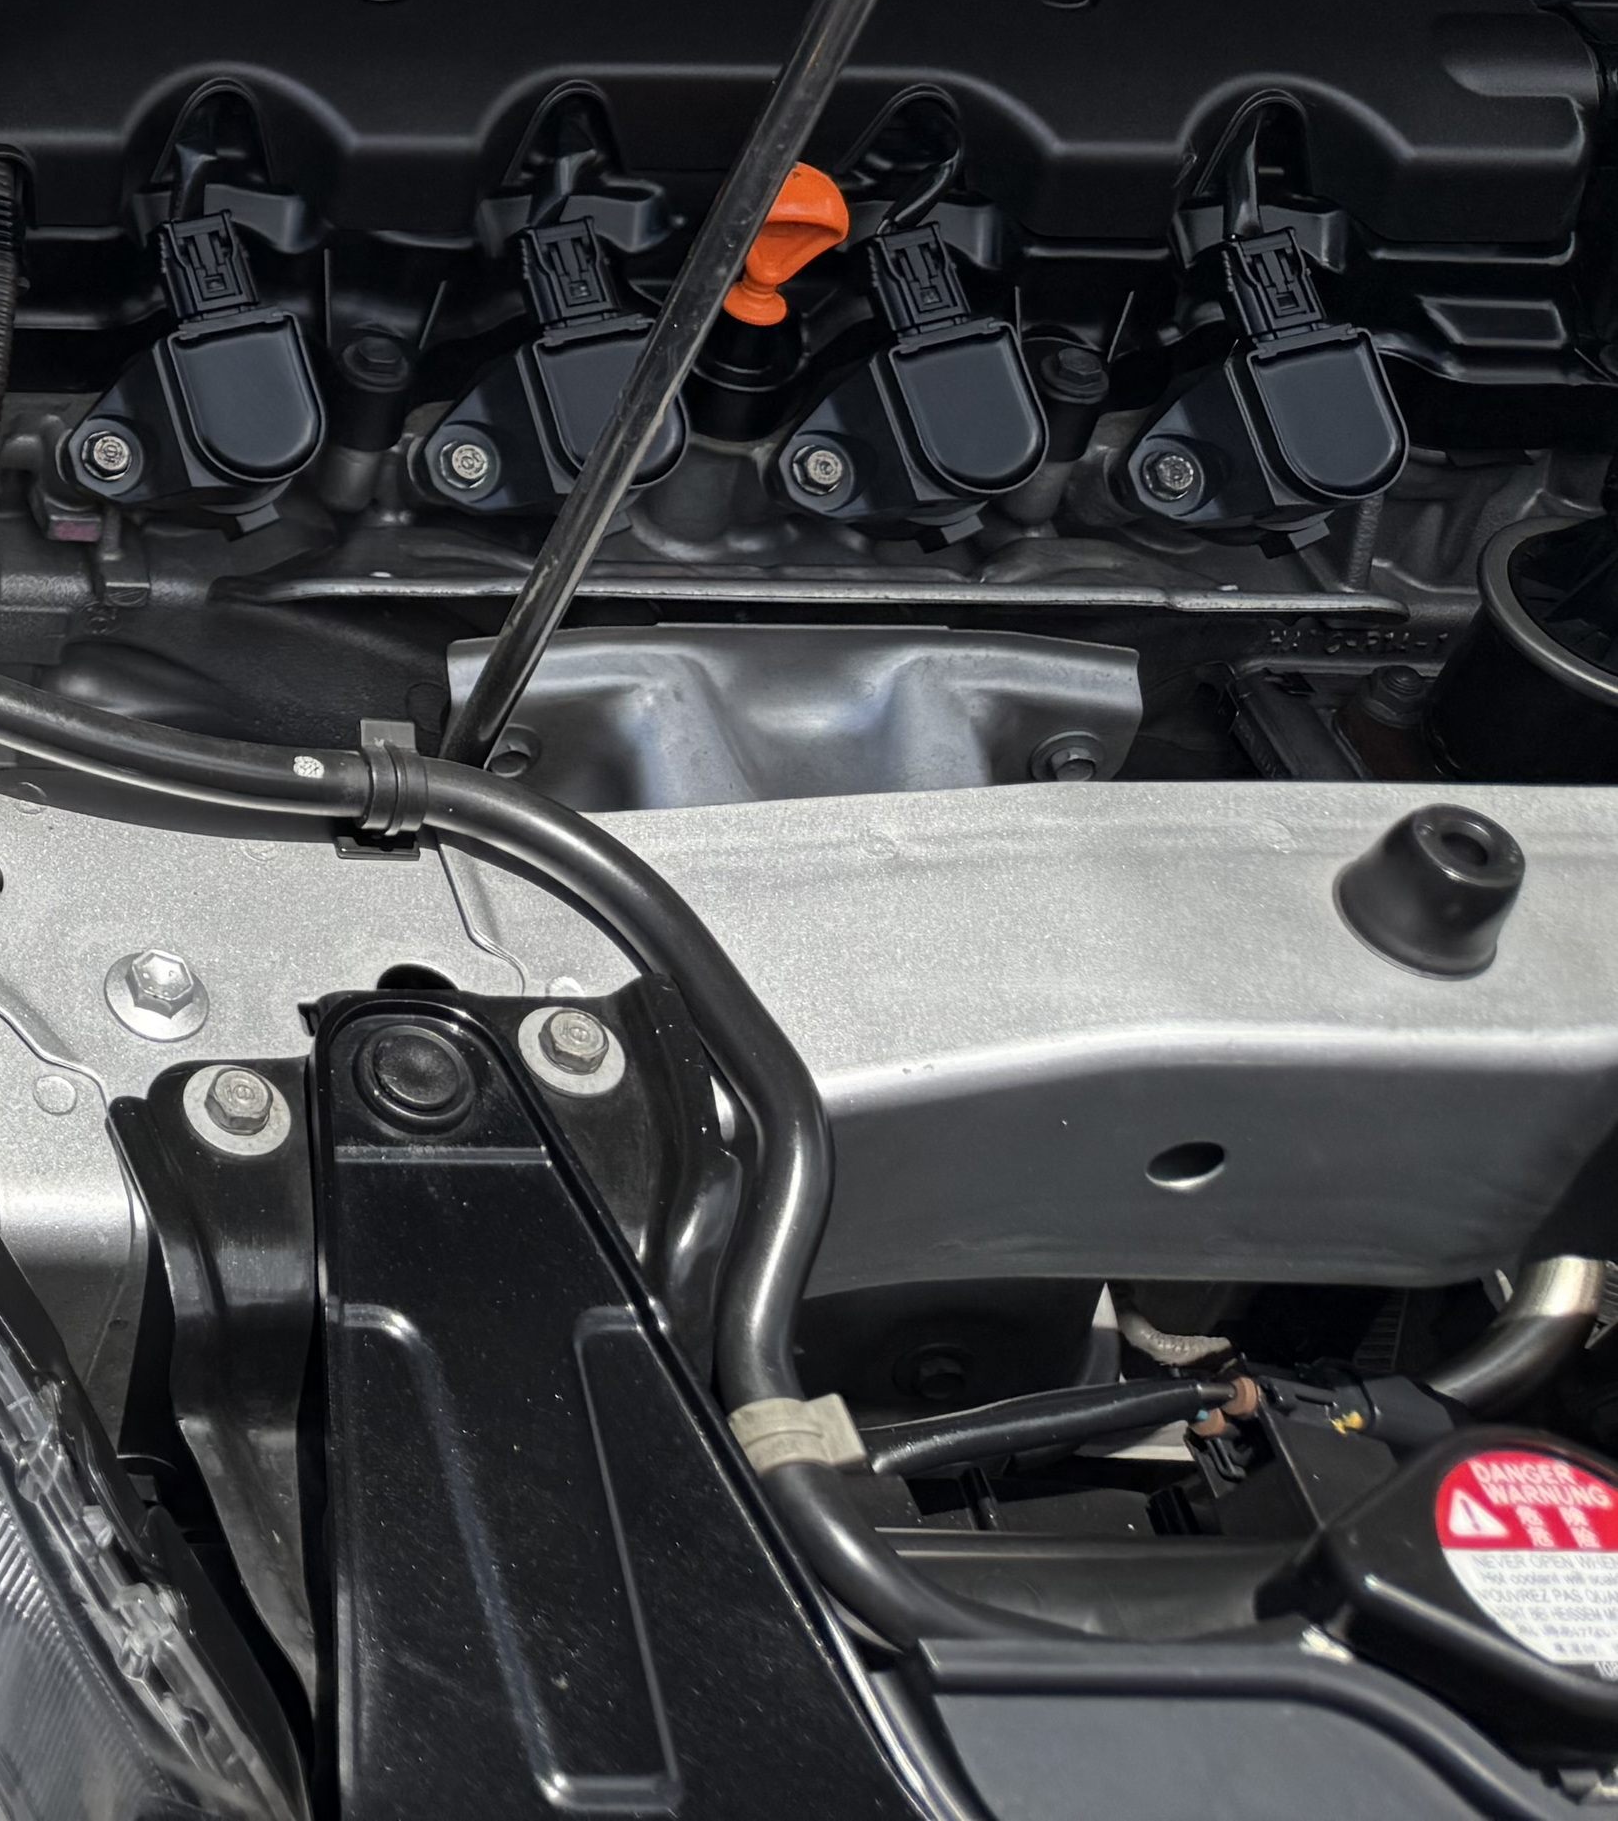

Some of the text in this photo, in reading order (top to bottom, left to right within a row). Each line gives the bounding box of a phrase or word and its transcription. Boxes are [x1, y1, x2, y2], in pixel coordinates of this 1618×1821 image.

[1467, 1459, 1577, 1486] DANGER
[1479, 1482, 1614, 1510] WARNUNG
[1472, 1555, 1528, 1569] NEVER
[1530, 1555, 1575, 1569] OPEN
[1552, 1589, 1584, 1604] PAS
